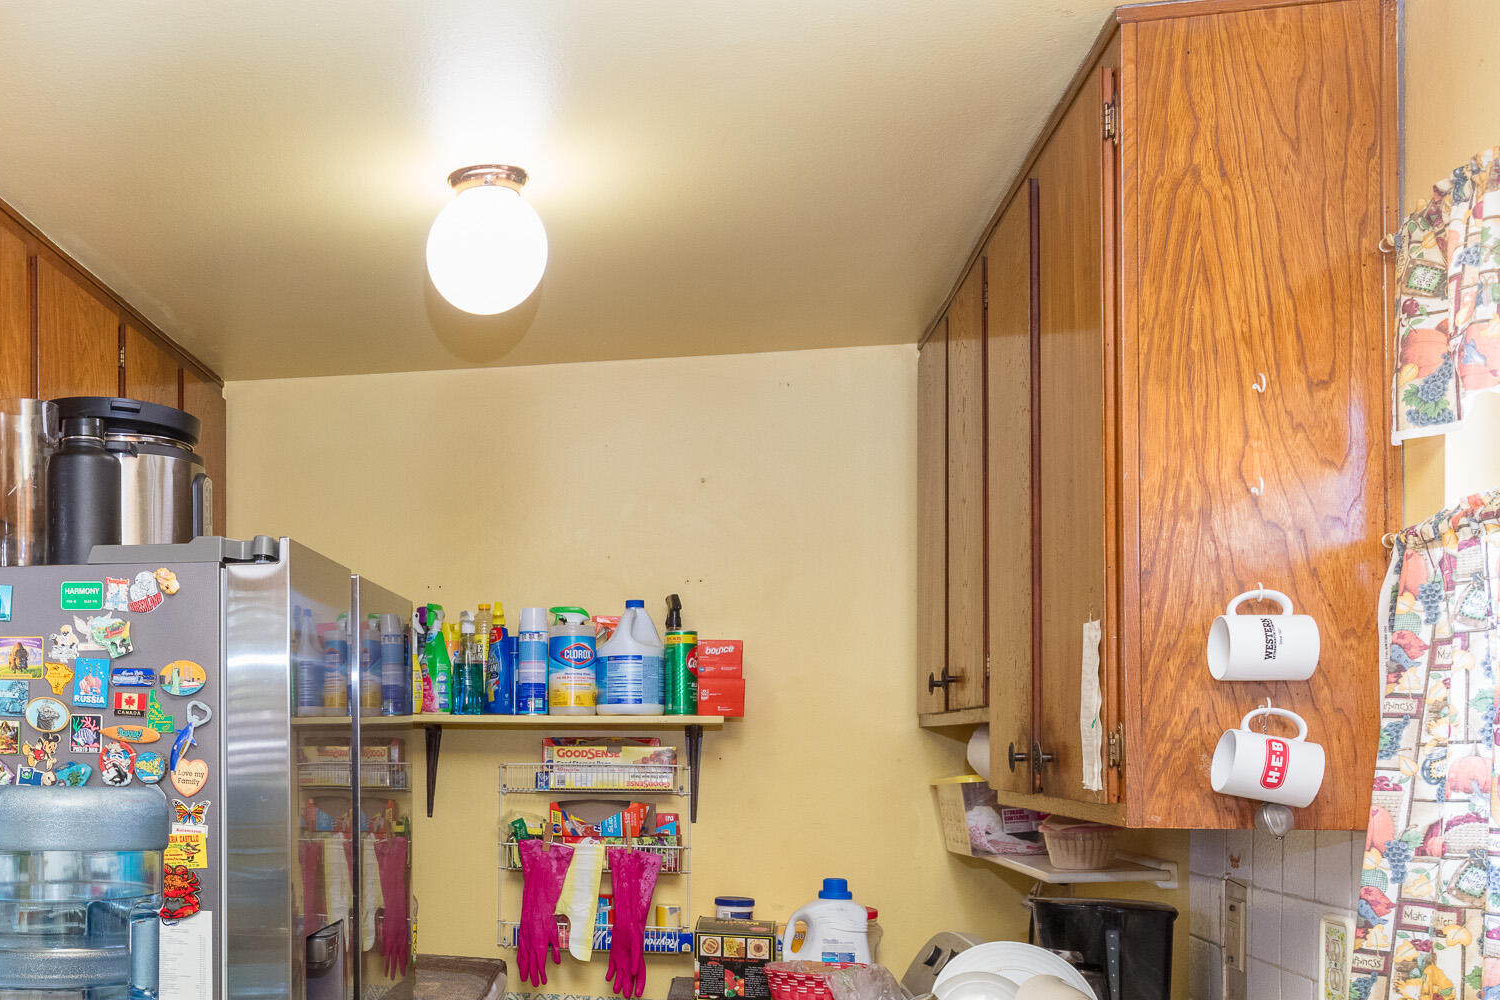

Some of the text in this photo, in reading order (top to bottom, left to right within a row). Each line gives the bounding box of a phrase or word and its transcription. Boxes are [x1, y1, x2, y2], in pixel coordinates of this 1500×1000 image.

[64, 587, 100, 595] HARMONY
[1260, 618, 1274, 660] WESTERN
[705, 645, 735, 655] bounce
[74, 694, 105, 704] RUSSIA
[178, 769, 192, 777] Love
[194, 771, 205, 779] my
[177, 778, 200, 786] Family
